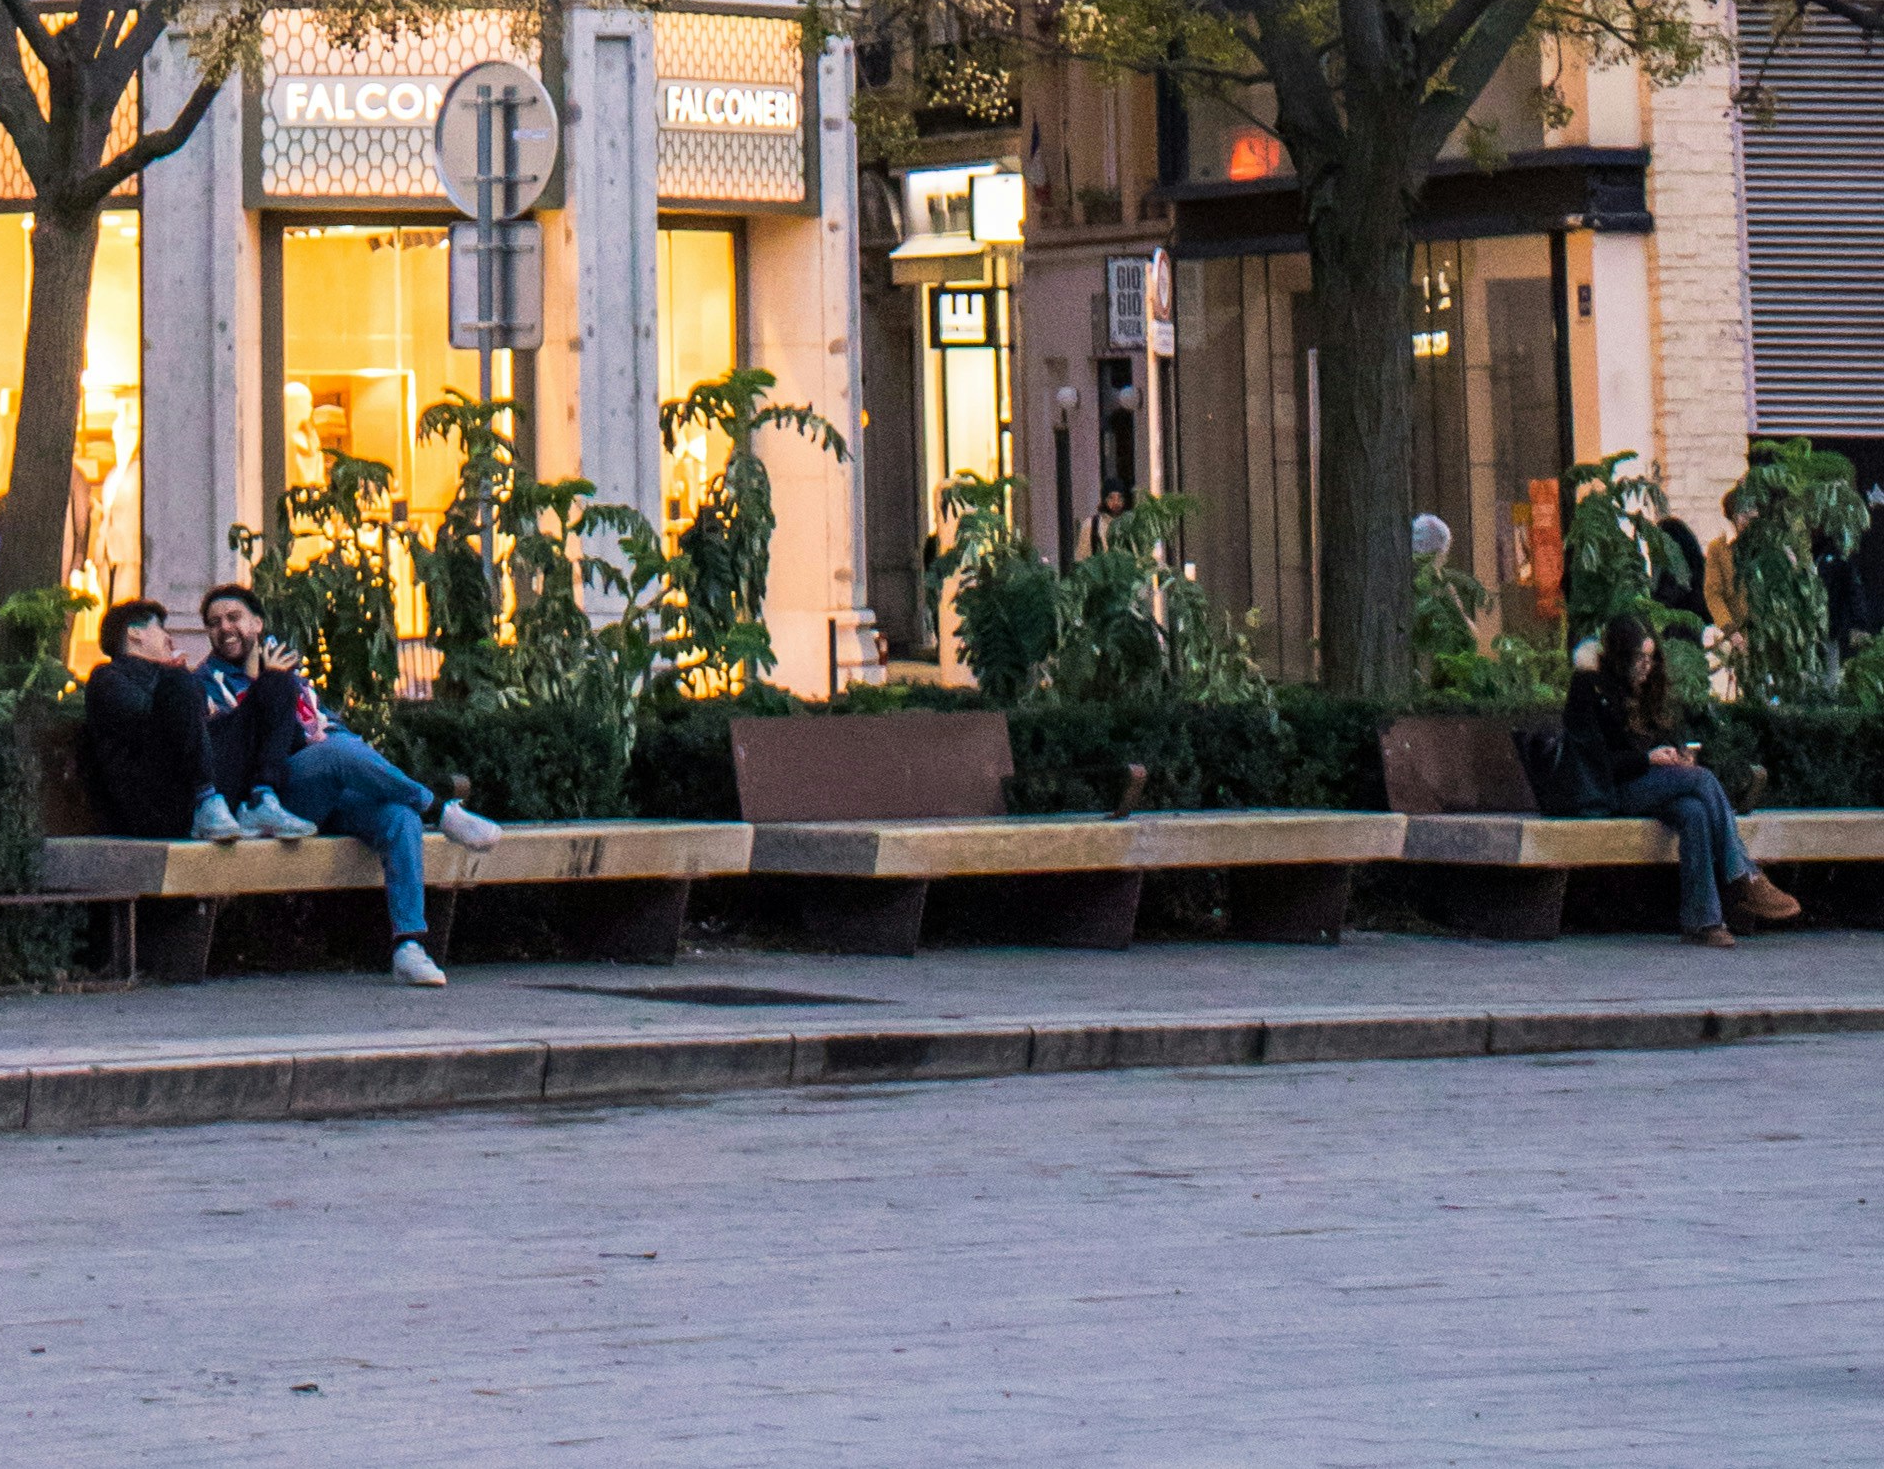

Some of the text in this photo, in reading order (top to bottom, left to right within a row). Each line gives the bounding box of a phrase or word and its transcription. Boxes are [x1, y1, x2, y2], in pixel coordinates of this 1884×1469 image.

[667, 85, 798, 128] FALCONERI
[1117, 265, 1141, 291] GIO
[1117, 292, 1142, 317] GIO
